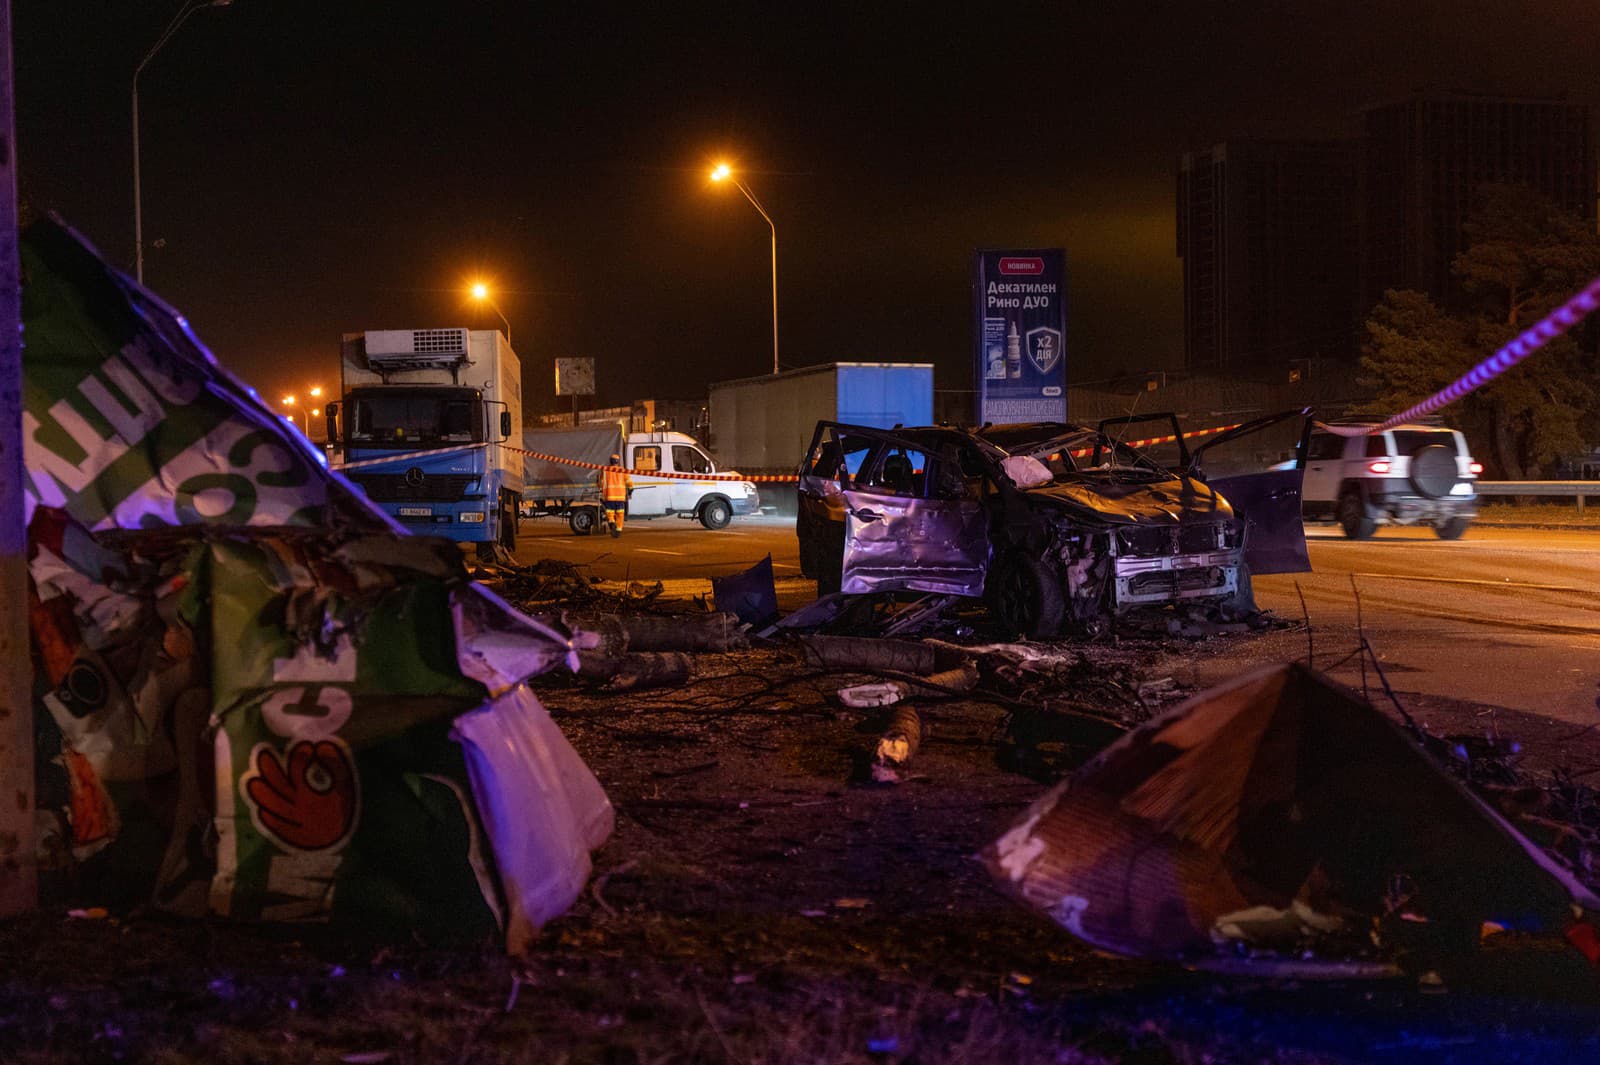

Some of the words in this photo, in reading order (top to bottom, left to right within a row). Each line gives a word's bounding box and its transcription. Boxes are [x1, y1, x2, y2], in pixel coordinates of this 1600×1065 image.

[987, 281, 1056, 295] Декатилен
[988, 296, 1020, 308] Рино
[1022, 296, 1049, 309] ДУО
[1036, 349, 1052, 361] ДІЯ
